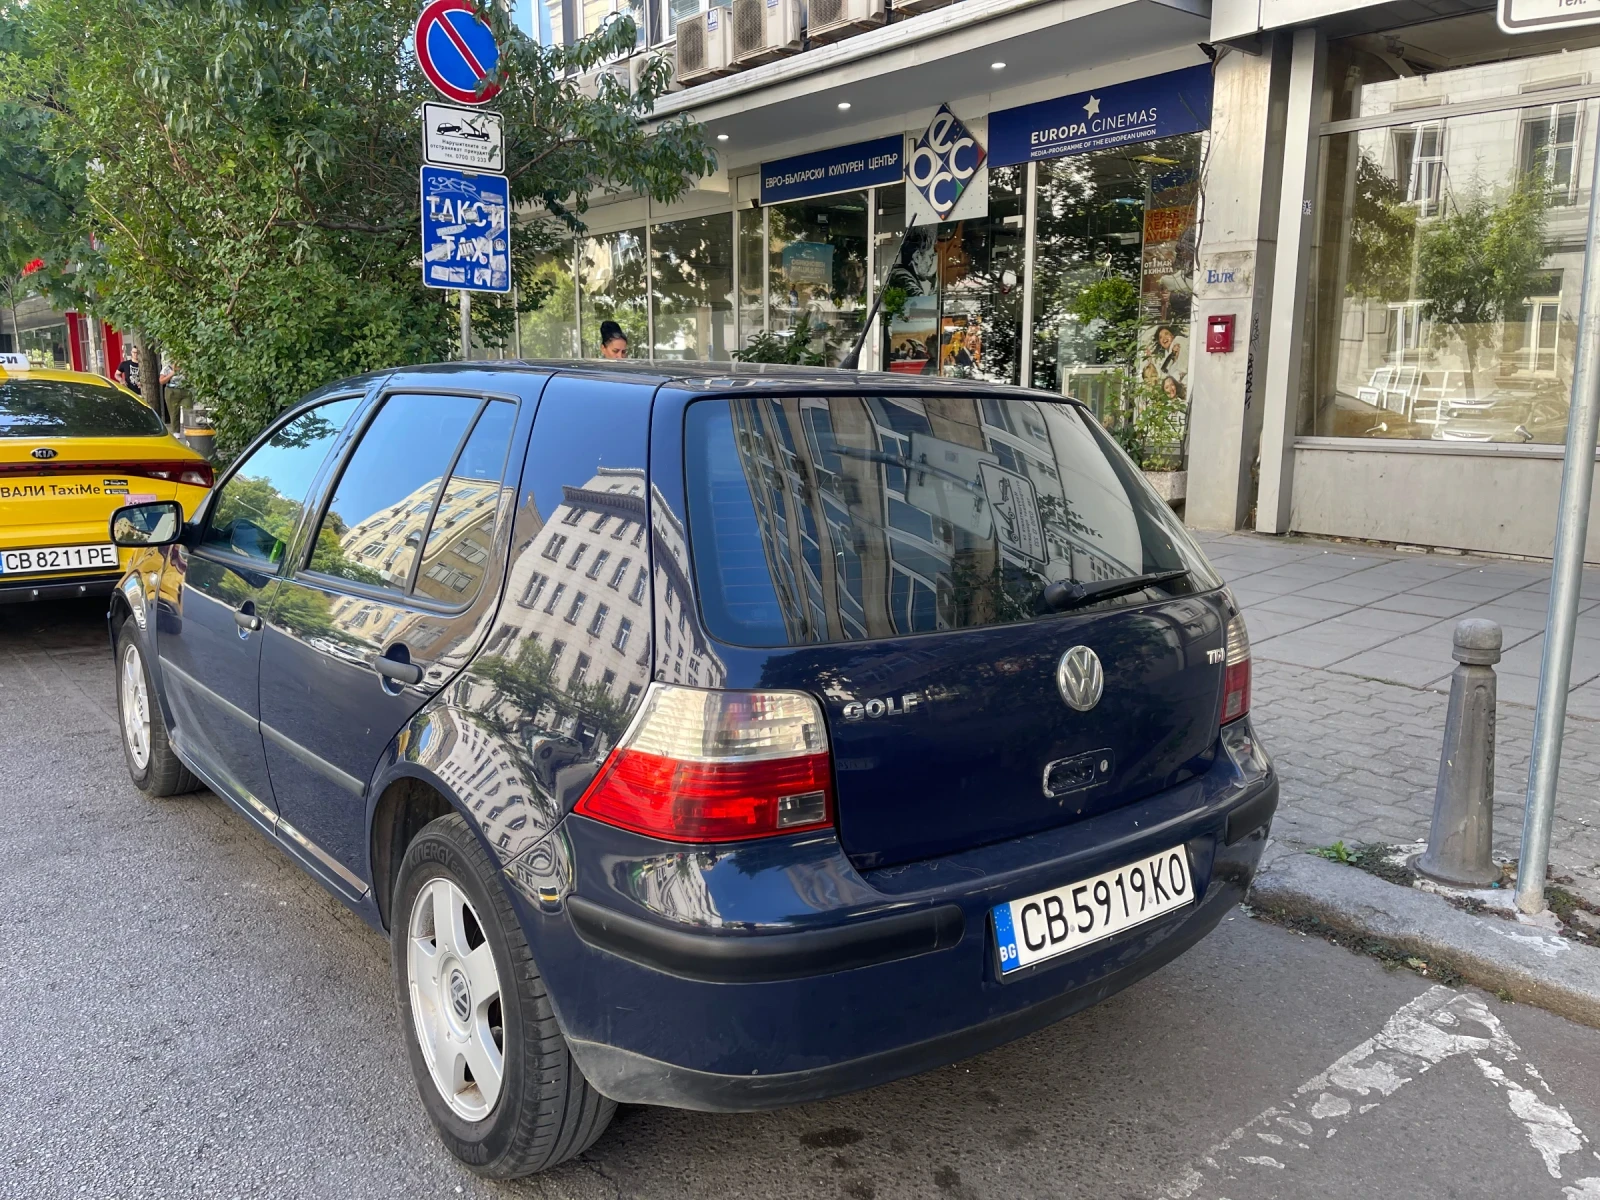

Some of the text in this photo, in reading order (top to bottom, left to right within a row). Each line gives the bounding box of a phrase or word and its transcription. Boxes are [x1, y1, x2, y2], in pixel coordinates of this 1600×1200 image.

[1031, 107, 1157, 144] EUROPA CINEMAS
[1030, 142, 1083, 158] MEDIA-PROGRAMME
[1093, 138, 1104, 146] THE
[1104, 132, 1136, 144] EUROPEAN
[1136, 128, 1157, 139] UNION
[765, 153, 898, 188] ЕВРО-БЪЛГАРСКИ КУЛТУРЕН ЦЕНТЪР
[442, 236, 493, 262] TAXI
[35, 450, 54, 458] KIA
[49, 484, 100, 496] TaxiMe
[37, 549, 83, 567] 8211
[88, 547, 113, 564] PE
[1206, 647, 1225, 665] TDI
[843, 694, 919, 721] GOLF
[1000, 943, 1017, 962] BG
